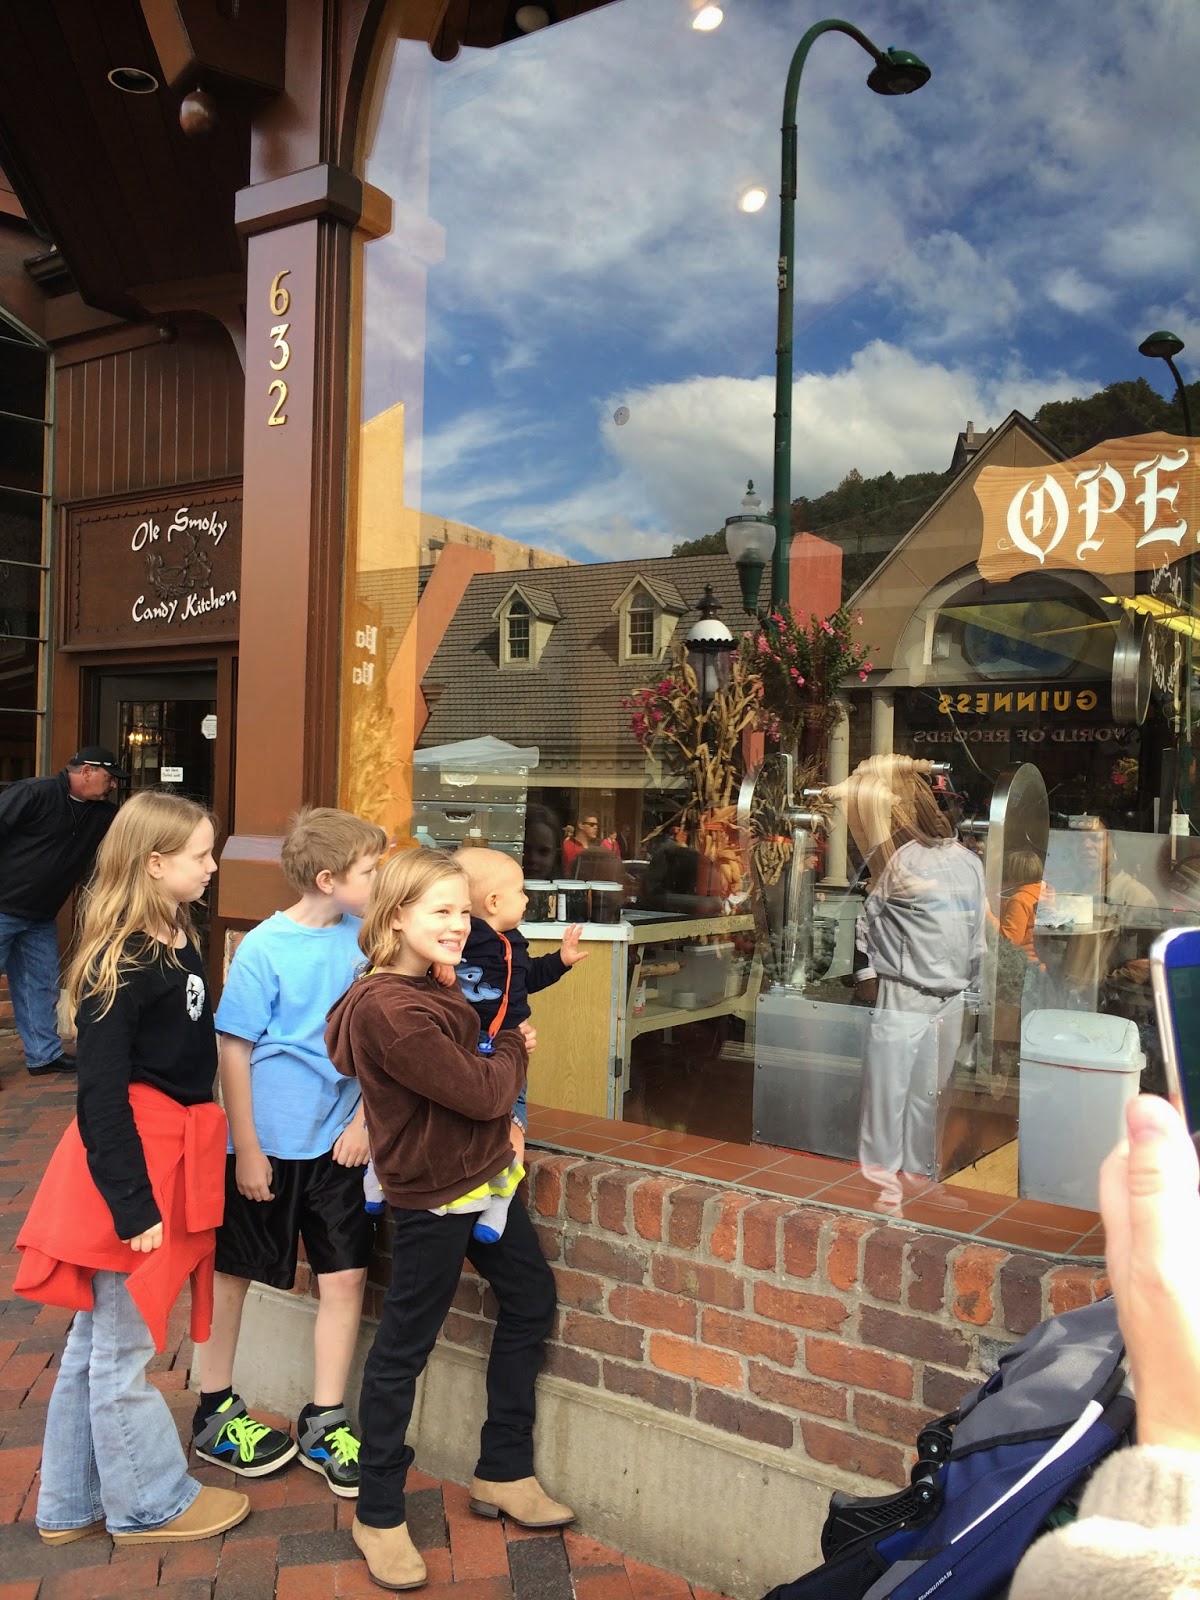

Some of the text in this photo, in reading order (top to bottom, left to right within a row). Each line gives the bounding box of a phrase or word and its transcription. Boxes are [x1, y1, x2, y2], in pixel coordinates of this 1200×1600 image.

[268, 269, 291, 427] 632
[131, 507, 227, 551] Ole Smoky
[997, 448, 1200, 564] OPE
[132, 586, 237, 623] Candy Kitchen
